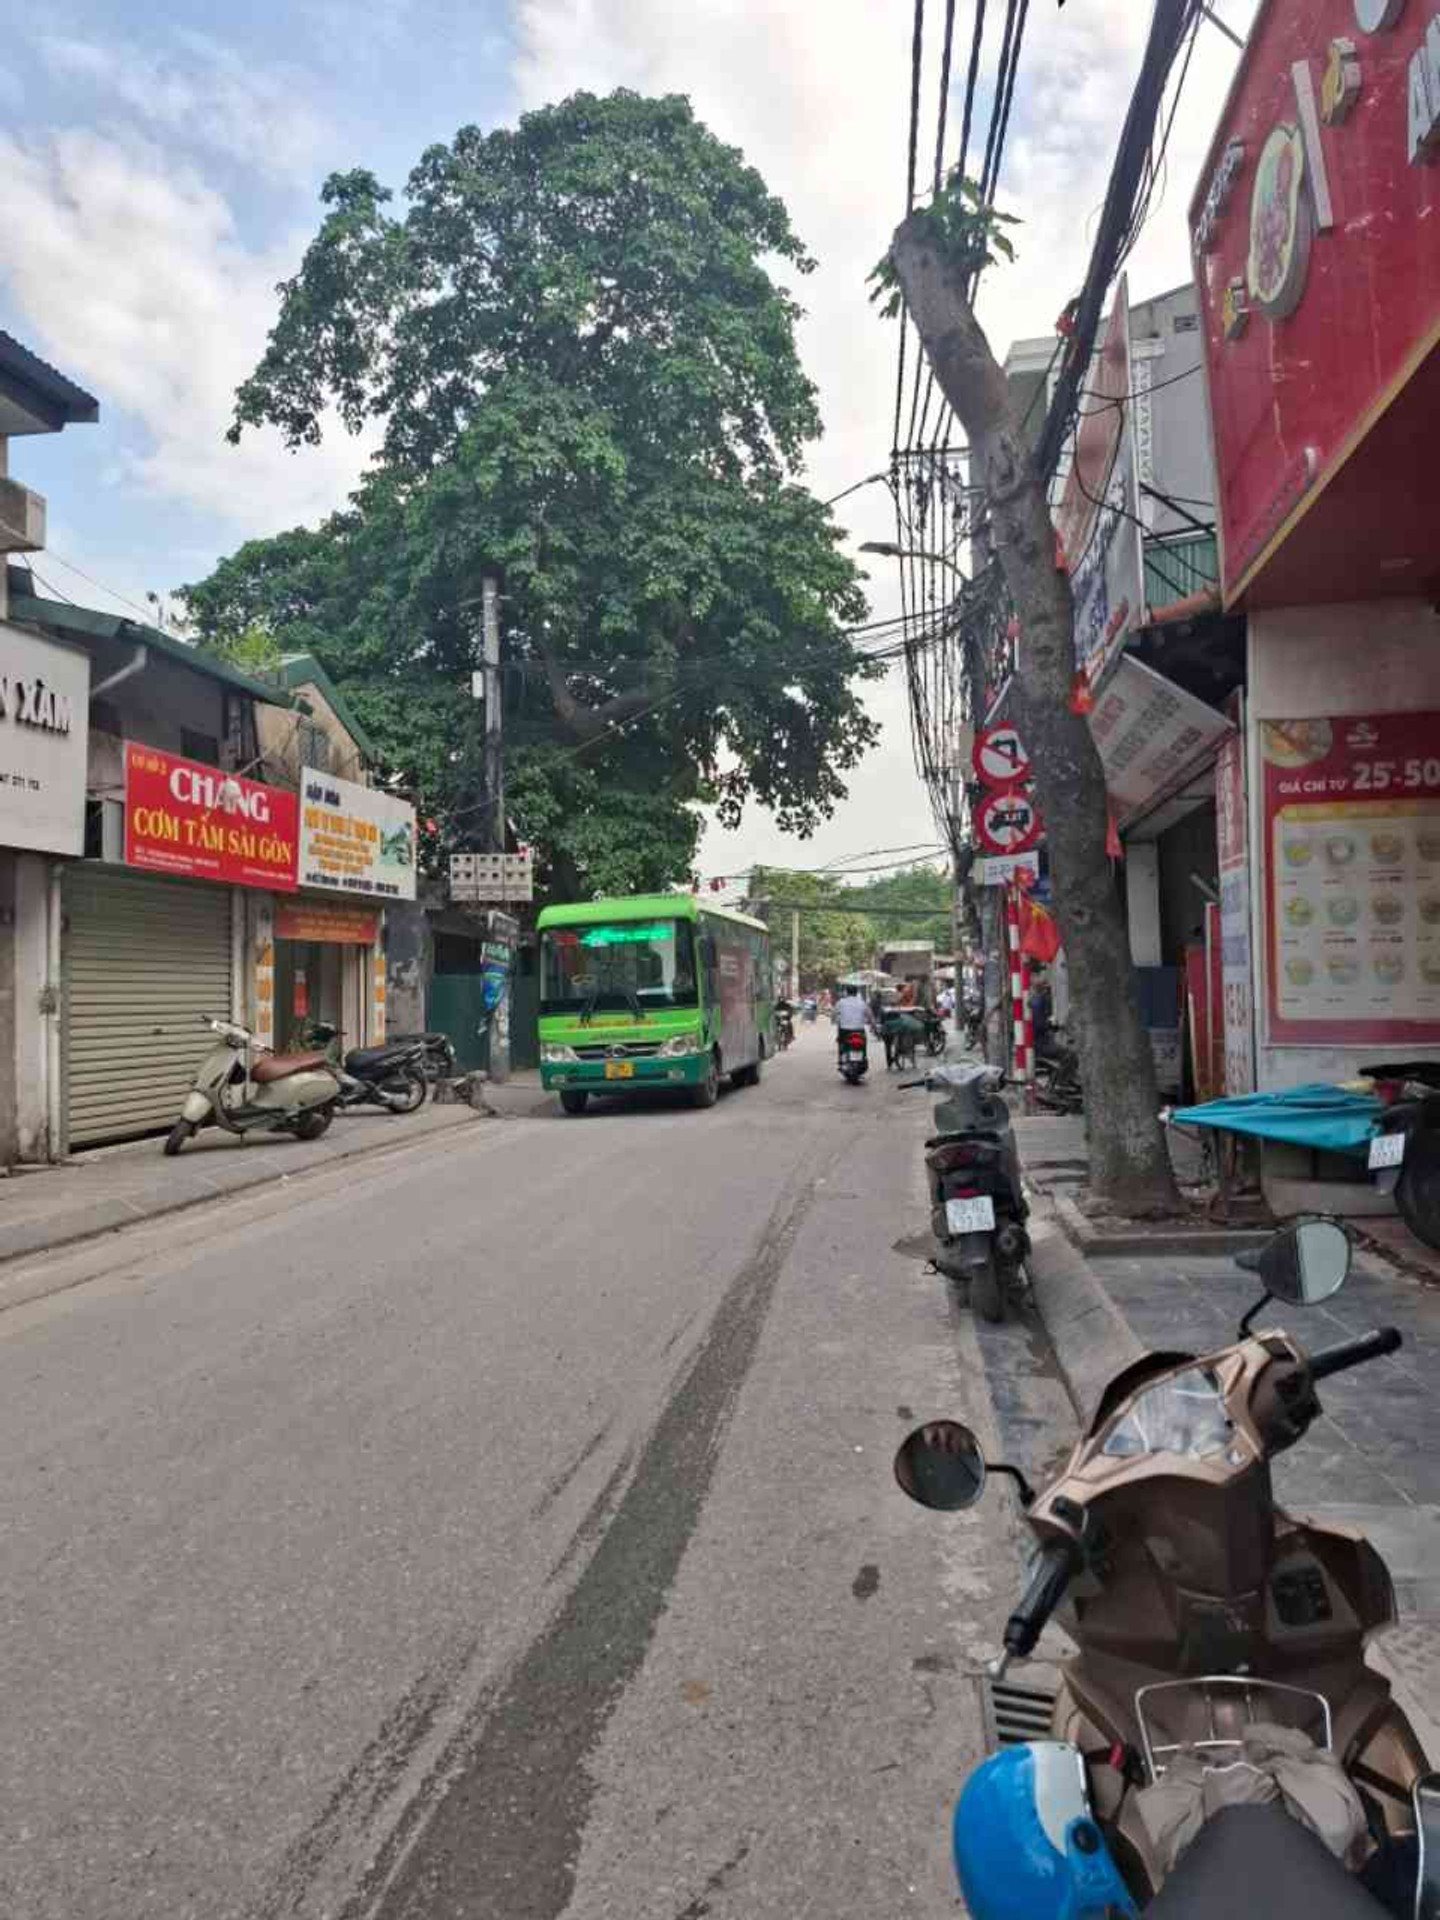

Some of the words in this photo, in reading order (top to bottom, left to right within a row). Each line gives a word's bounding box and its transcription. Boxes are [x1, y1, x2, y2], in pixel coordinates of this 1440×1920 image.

[133, 804, 179, 842] CƠM
[184, 809, 224, 853] TẤM
[227, 825, 255, 860] SÀI
[259, 832, 293, 864] GÒN
